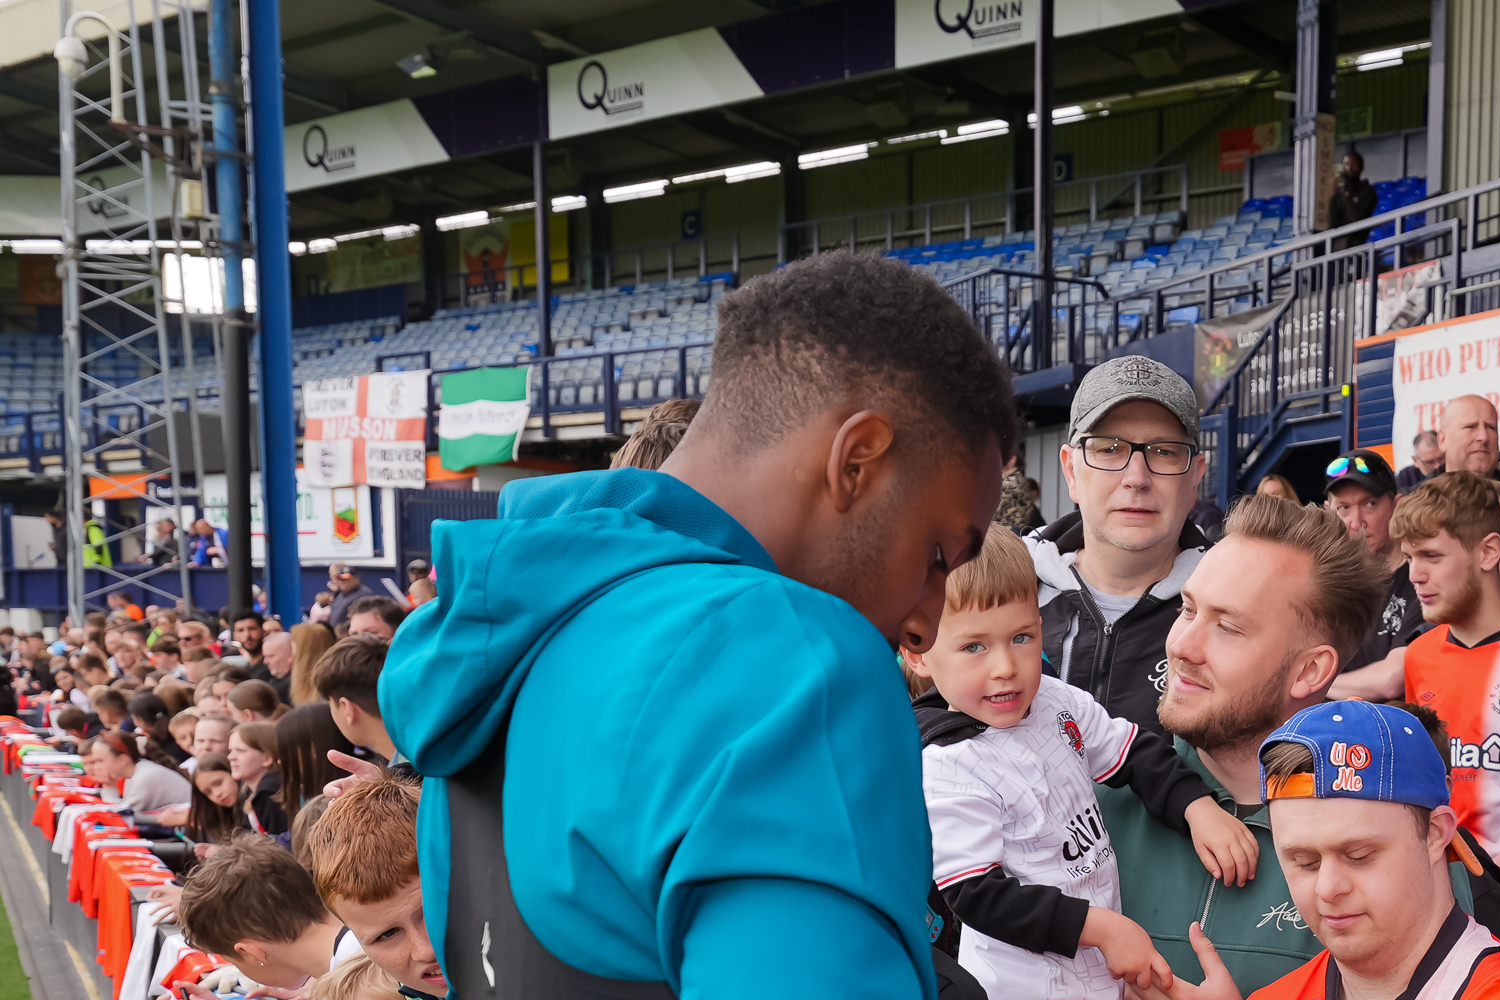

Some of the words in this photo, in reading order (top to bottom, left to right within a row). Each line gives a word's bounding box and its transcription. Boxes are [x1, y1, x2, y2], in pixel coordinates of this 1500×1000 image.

[934, 0, 1022, 39] QUINN
[577, 60, 643, 115] QUINN
[683, 214, 698, 234] C
[1399, 346, 1451, 384] WHO
[321, 416, 398, 441] MUSSON
[1331, 766, 1364, 792] Me
[1067, 865, 1092, 879] life
